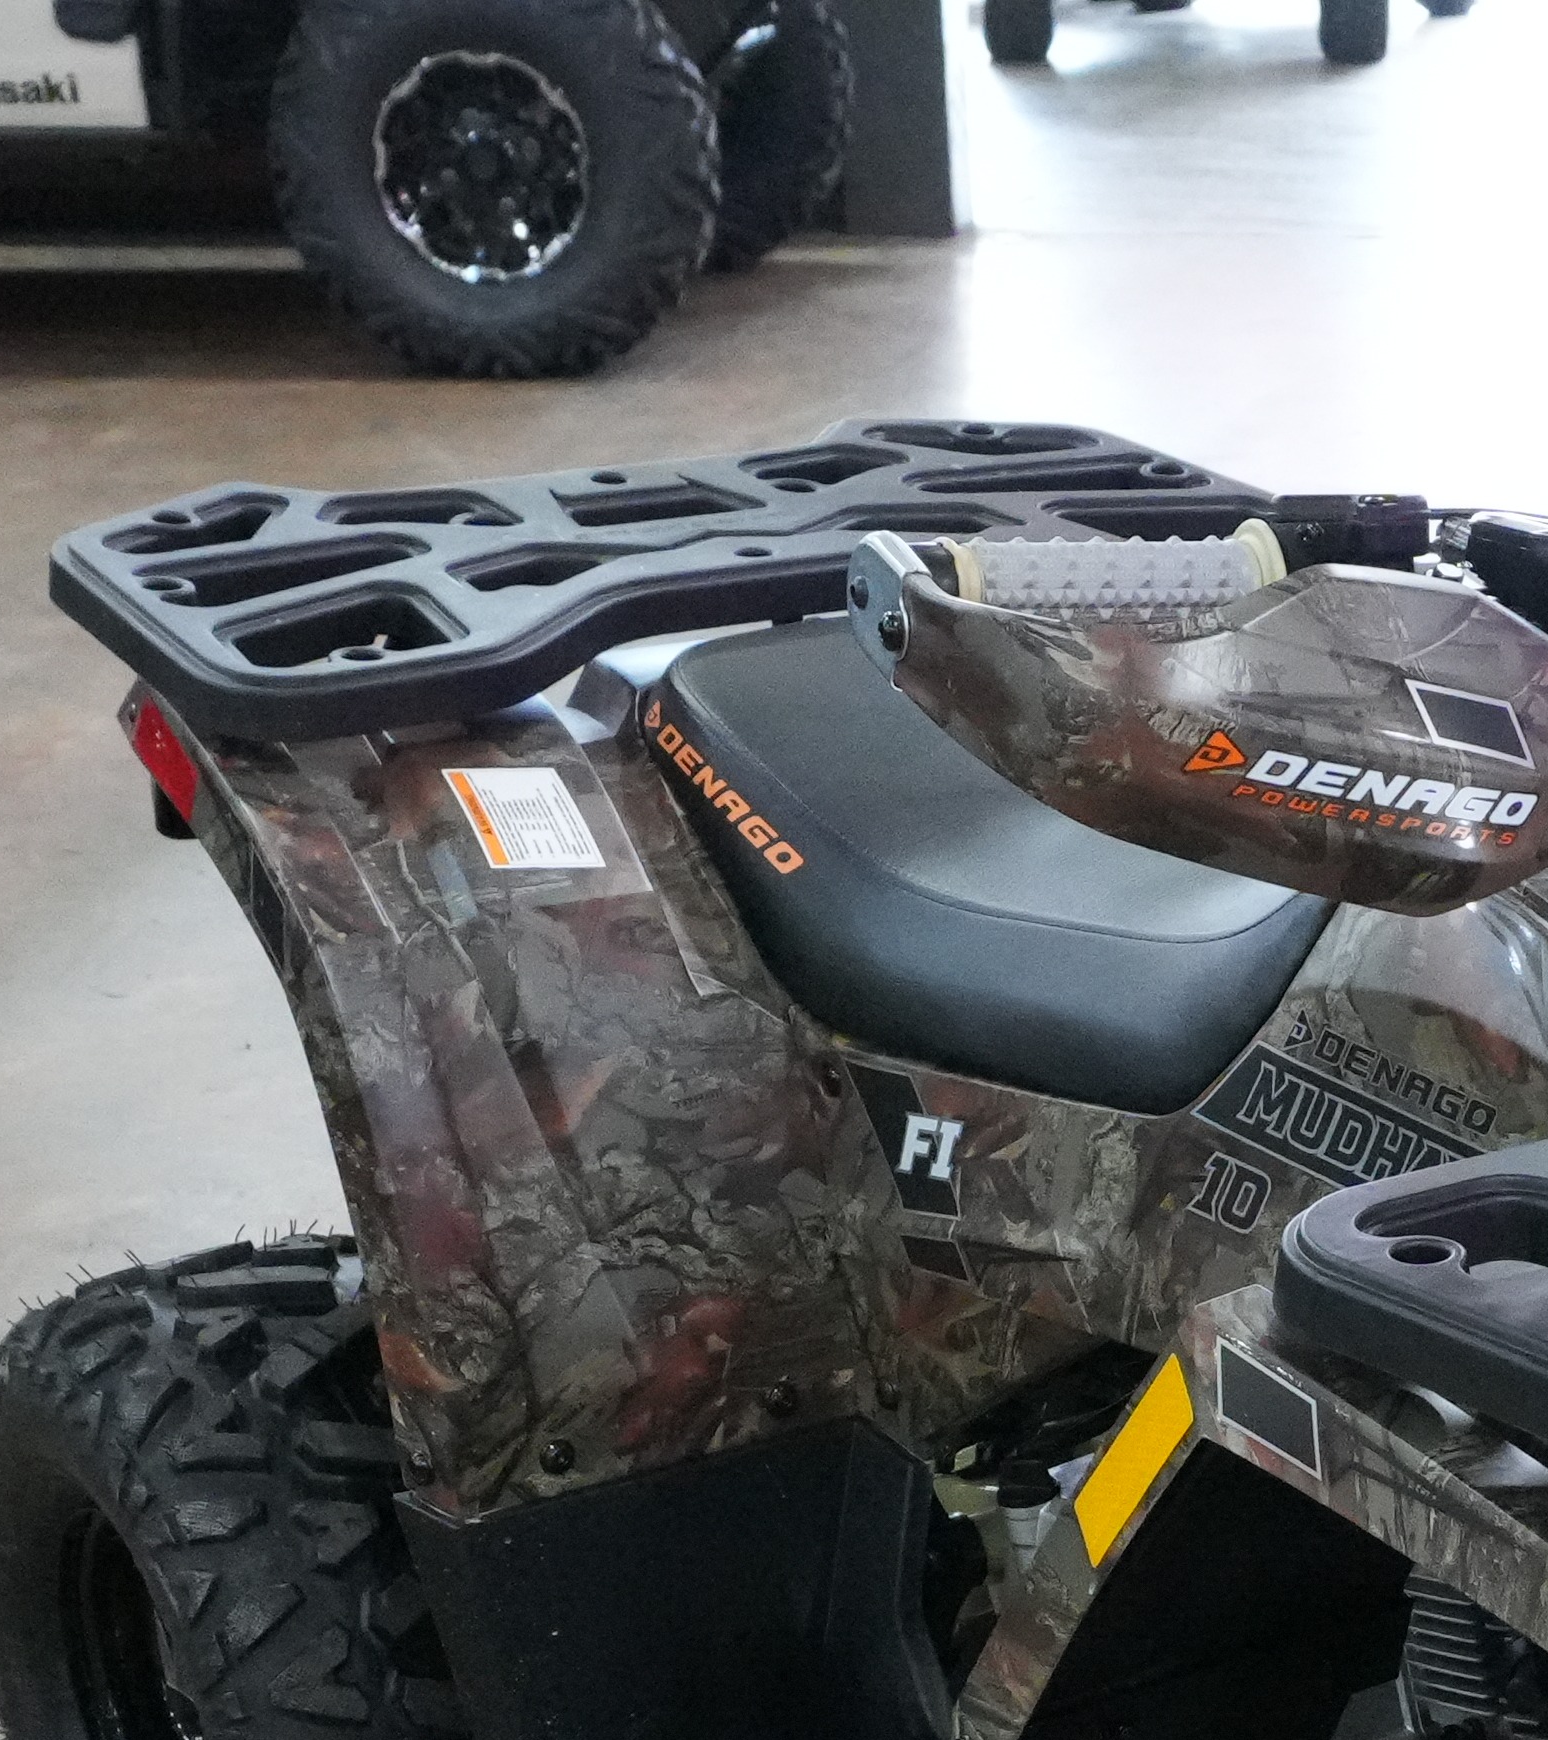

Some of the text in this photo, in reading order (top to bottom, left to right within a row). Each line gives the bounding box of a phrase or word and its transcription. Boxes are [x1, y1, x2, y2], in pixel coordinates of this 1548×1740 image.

[656, 723, 805, 875] DENAGO
[1231, 784, 1518, 846] POWERSPORTS
[1244, 749, 1539, 827] DENAGO
[1312, 1027, 1499, 1137] DENAGO
[893, 1111, 964, 1182] FI
